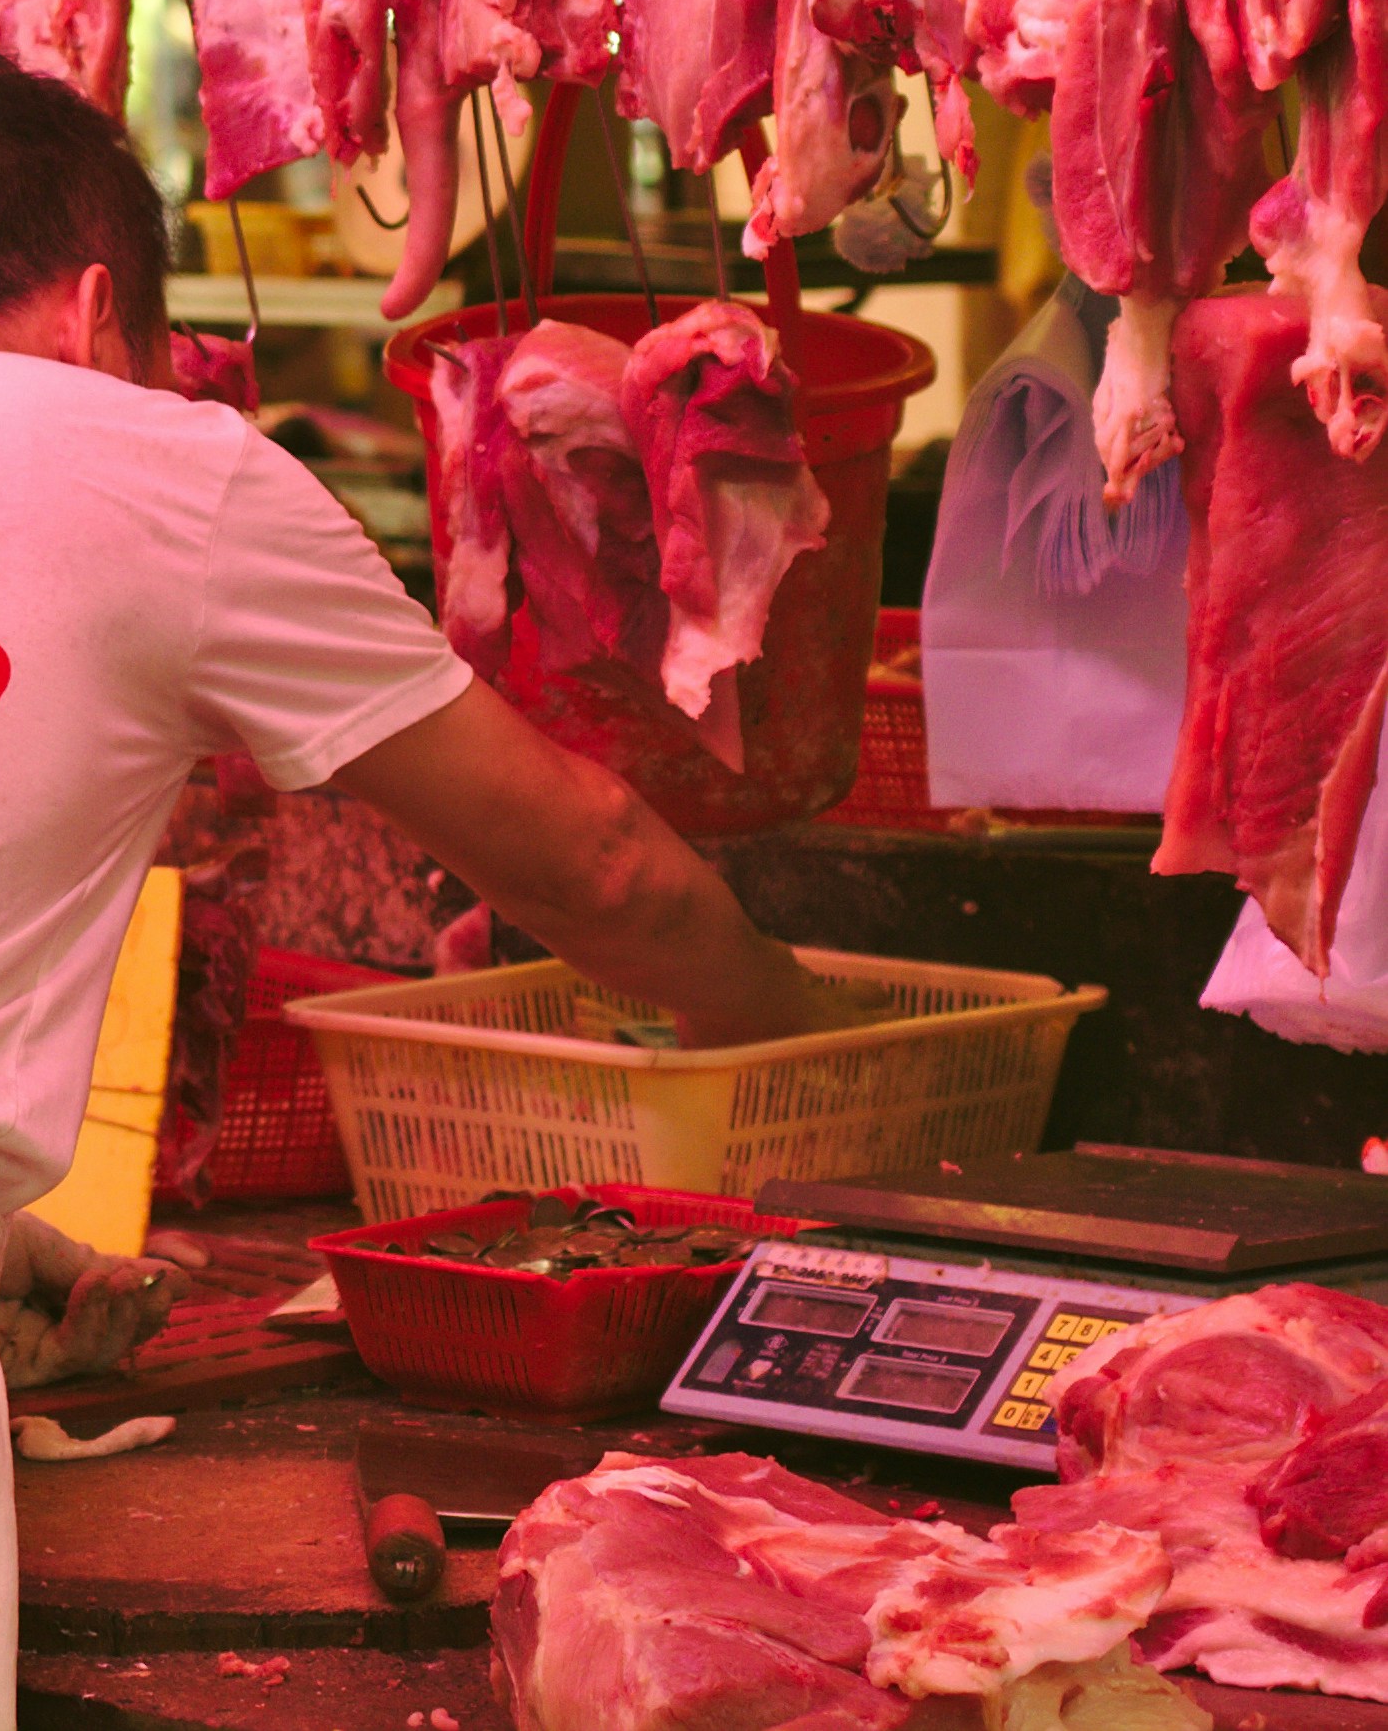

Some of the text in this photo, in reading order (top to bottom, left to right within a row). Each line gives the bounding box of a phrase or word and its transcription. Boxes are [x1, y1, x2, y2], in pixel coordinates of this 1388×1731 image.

[1057, 1319, 1071, 1333] 7
[1080, 1323, 1094, 1337] 8
[1038, 1349, 1052, 1362] 4
